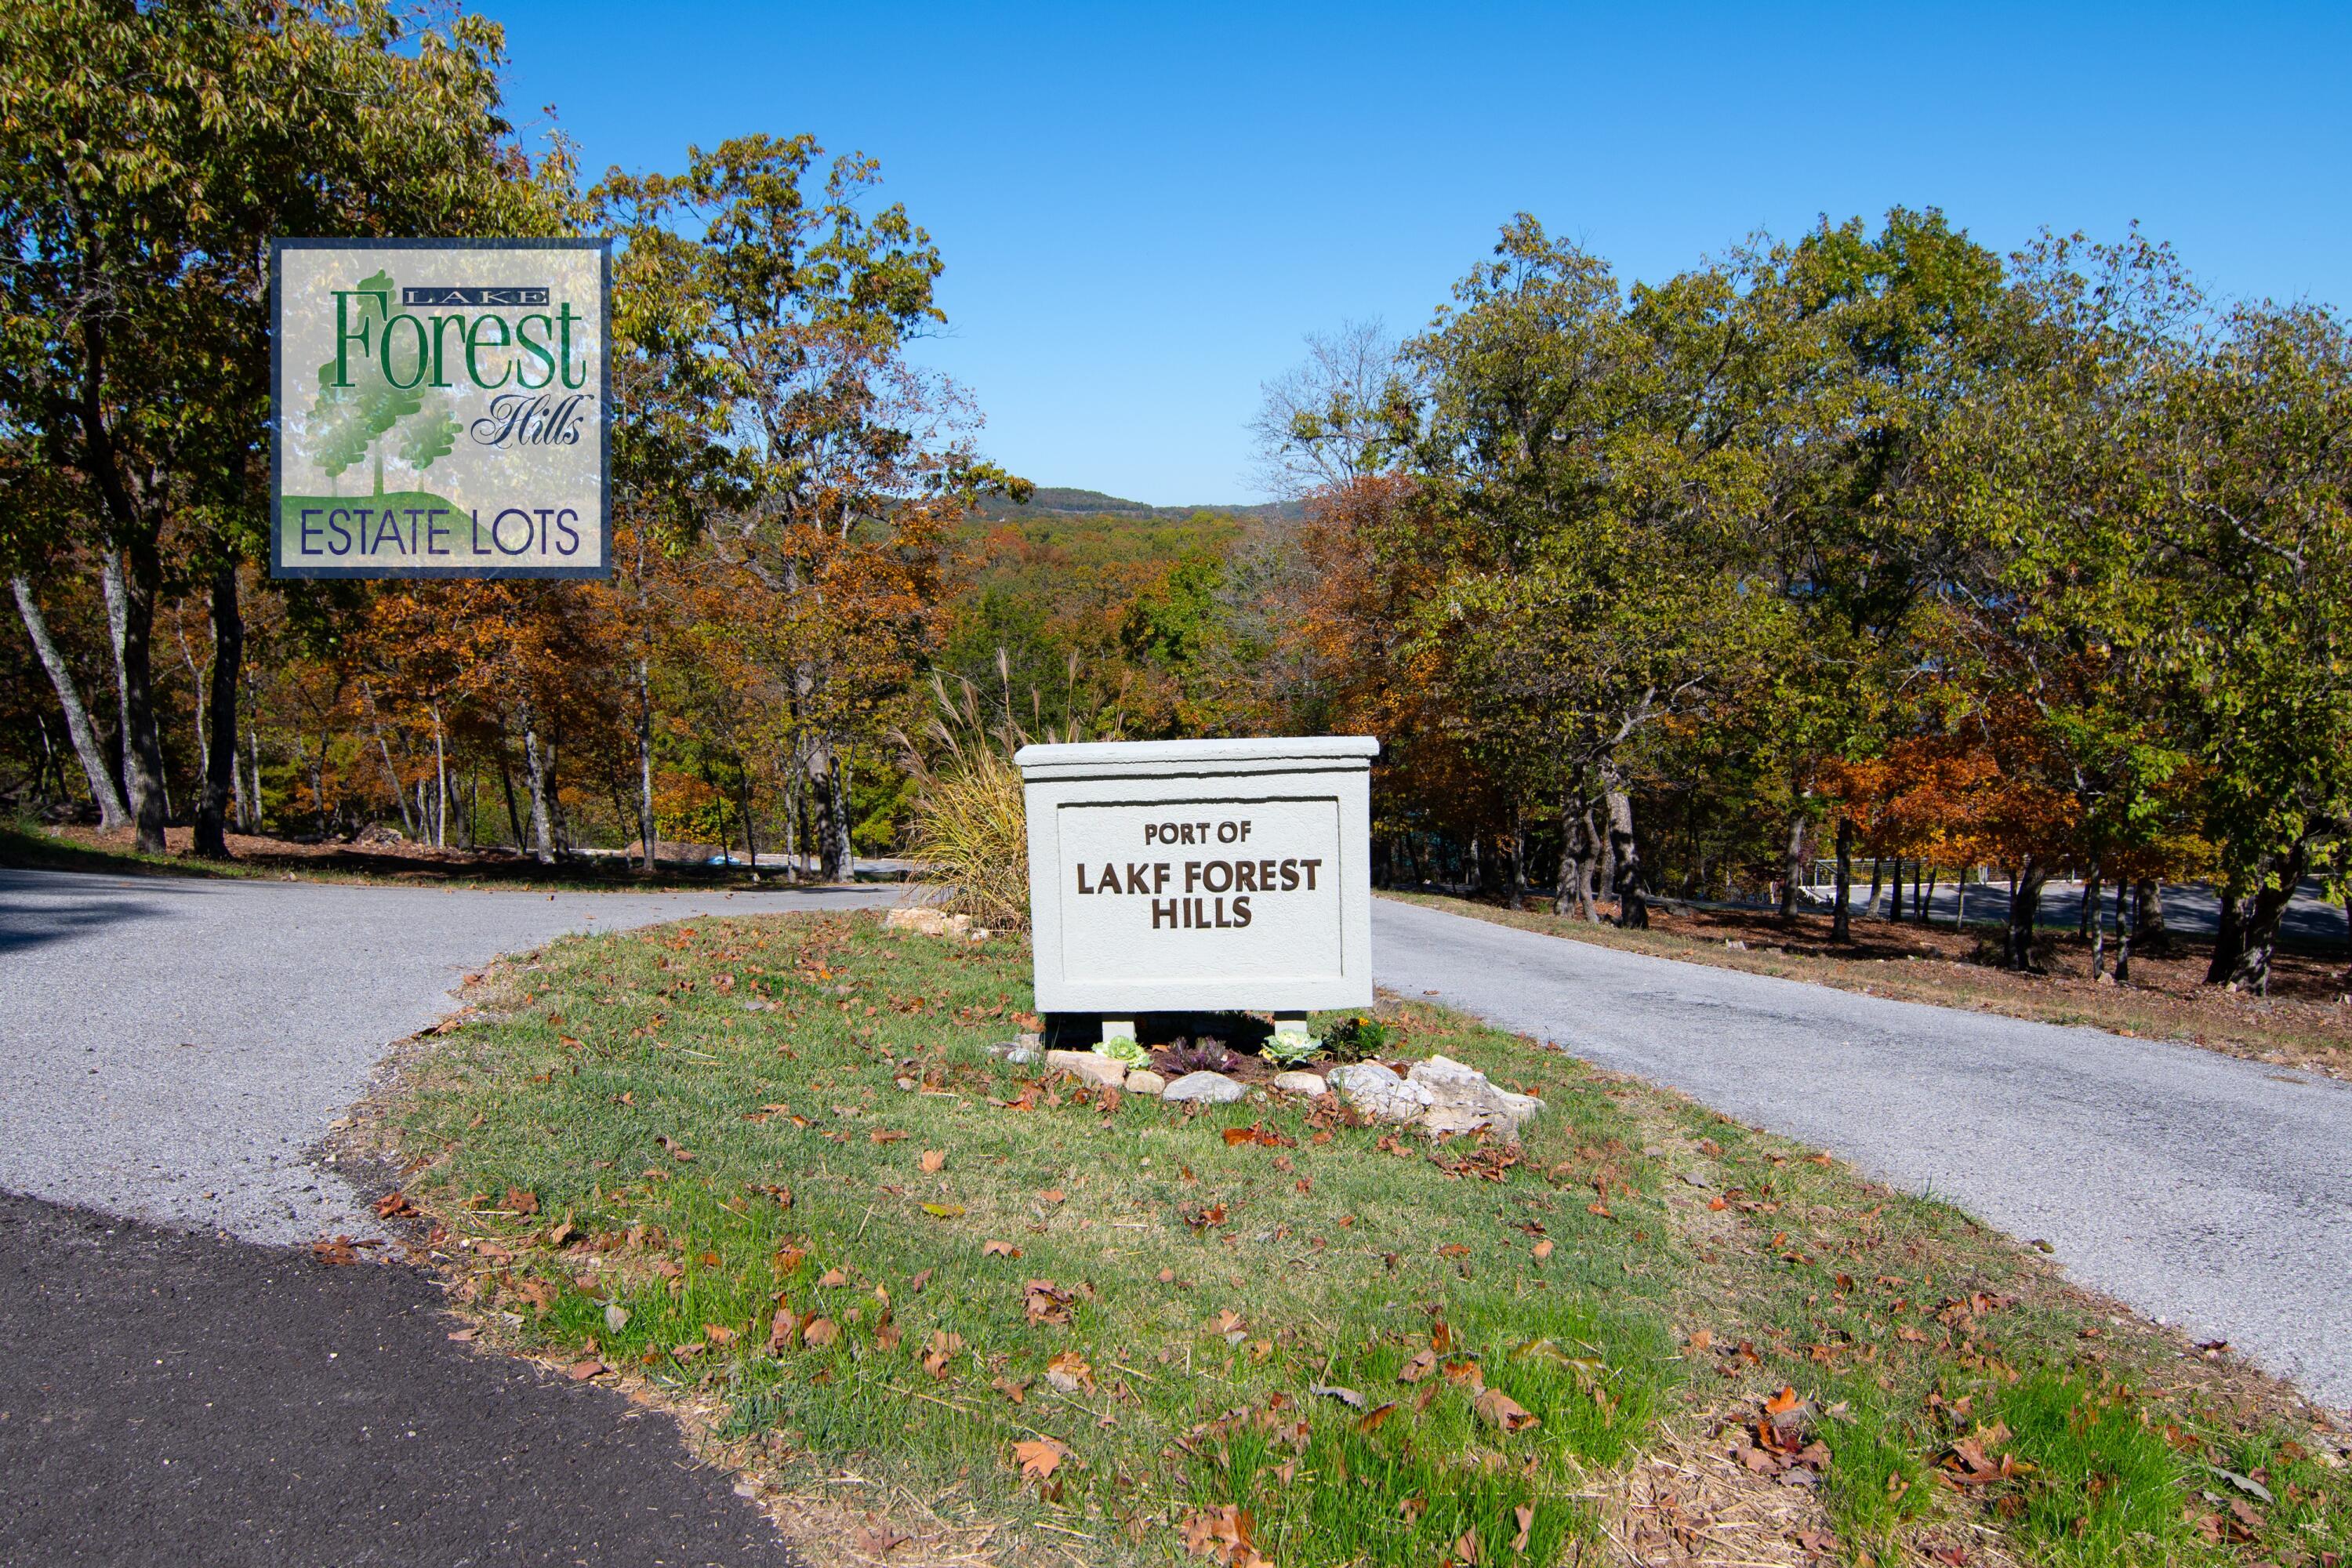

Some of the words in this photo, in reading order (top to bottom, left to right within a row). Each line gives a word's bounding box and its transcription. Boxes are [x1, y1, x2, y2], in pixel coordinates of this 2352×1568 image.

[1145, 822, 1210, 846] PORT
[1217, 820, 1251, 844] OF
[1185, 858, 1323, 894] FOREST
[1152, 895, 1252, 930] HILLS
